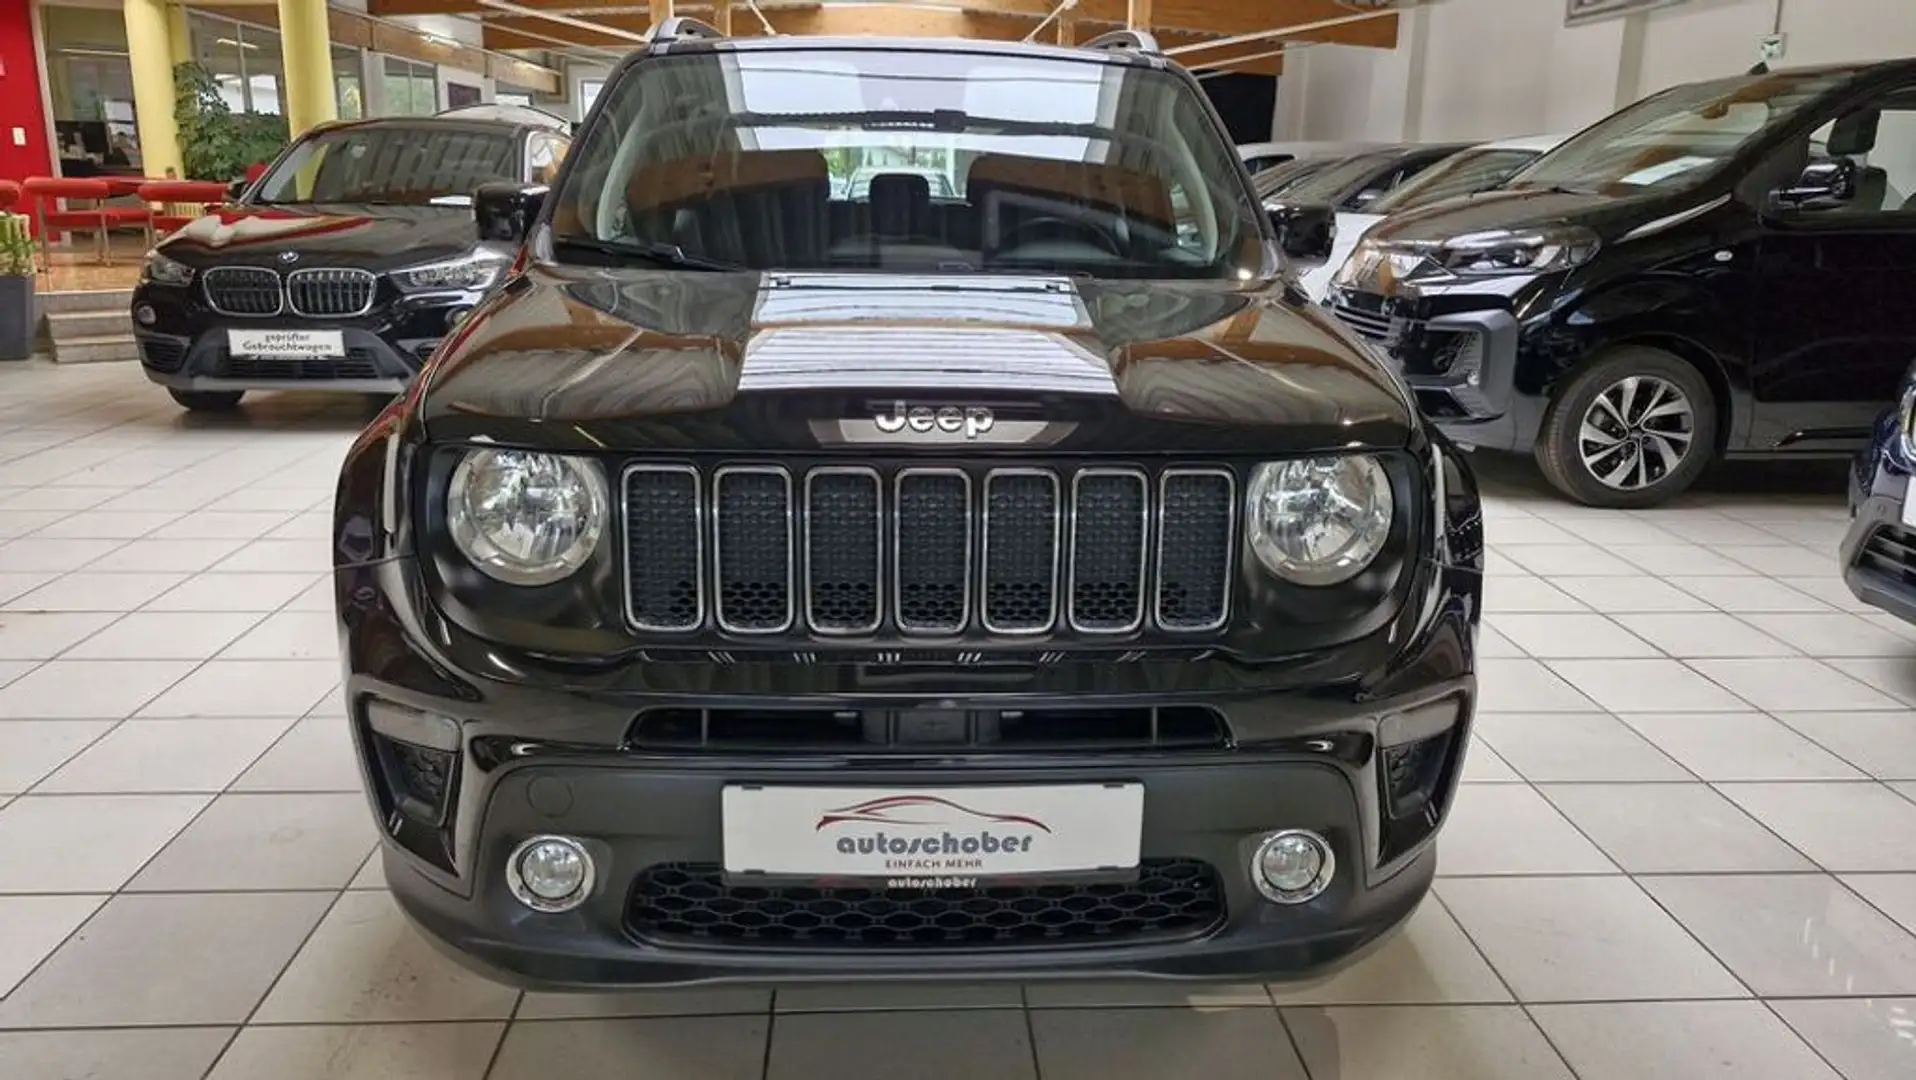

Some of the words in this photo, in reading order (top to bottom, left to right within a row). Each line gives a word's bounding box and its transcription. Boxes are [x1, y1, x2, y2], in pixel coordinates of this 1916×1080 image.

[241, 341, 333, 352] Gebrauchtwagen
[874, 399, 995, 439] Jeep
[836, 831, 1033, 855] autoschober
[884, 858, 941, 869] EINFACH
[944, 858, 983, 868] MEHR
[886, 876, 978, 889] autoschober
